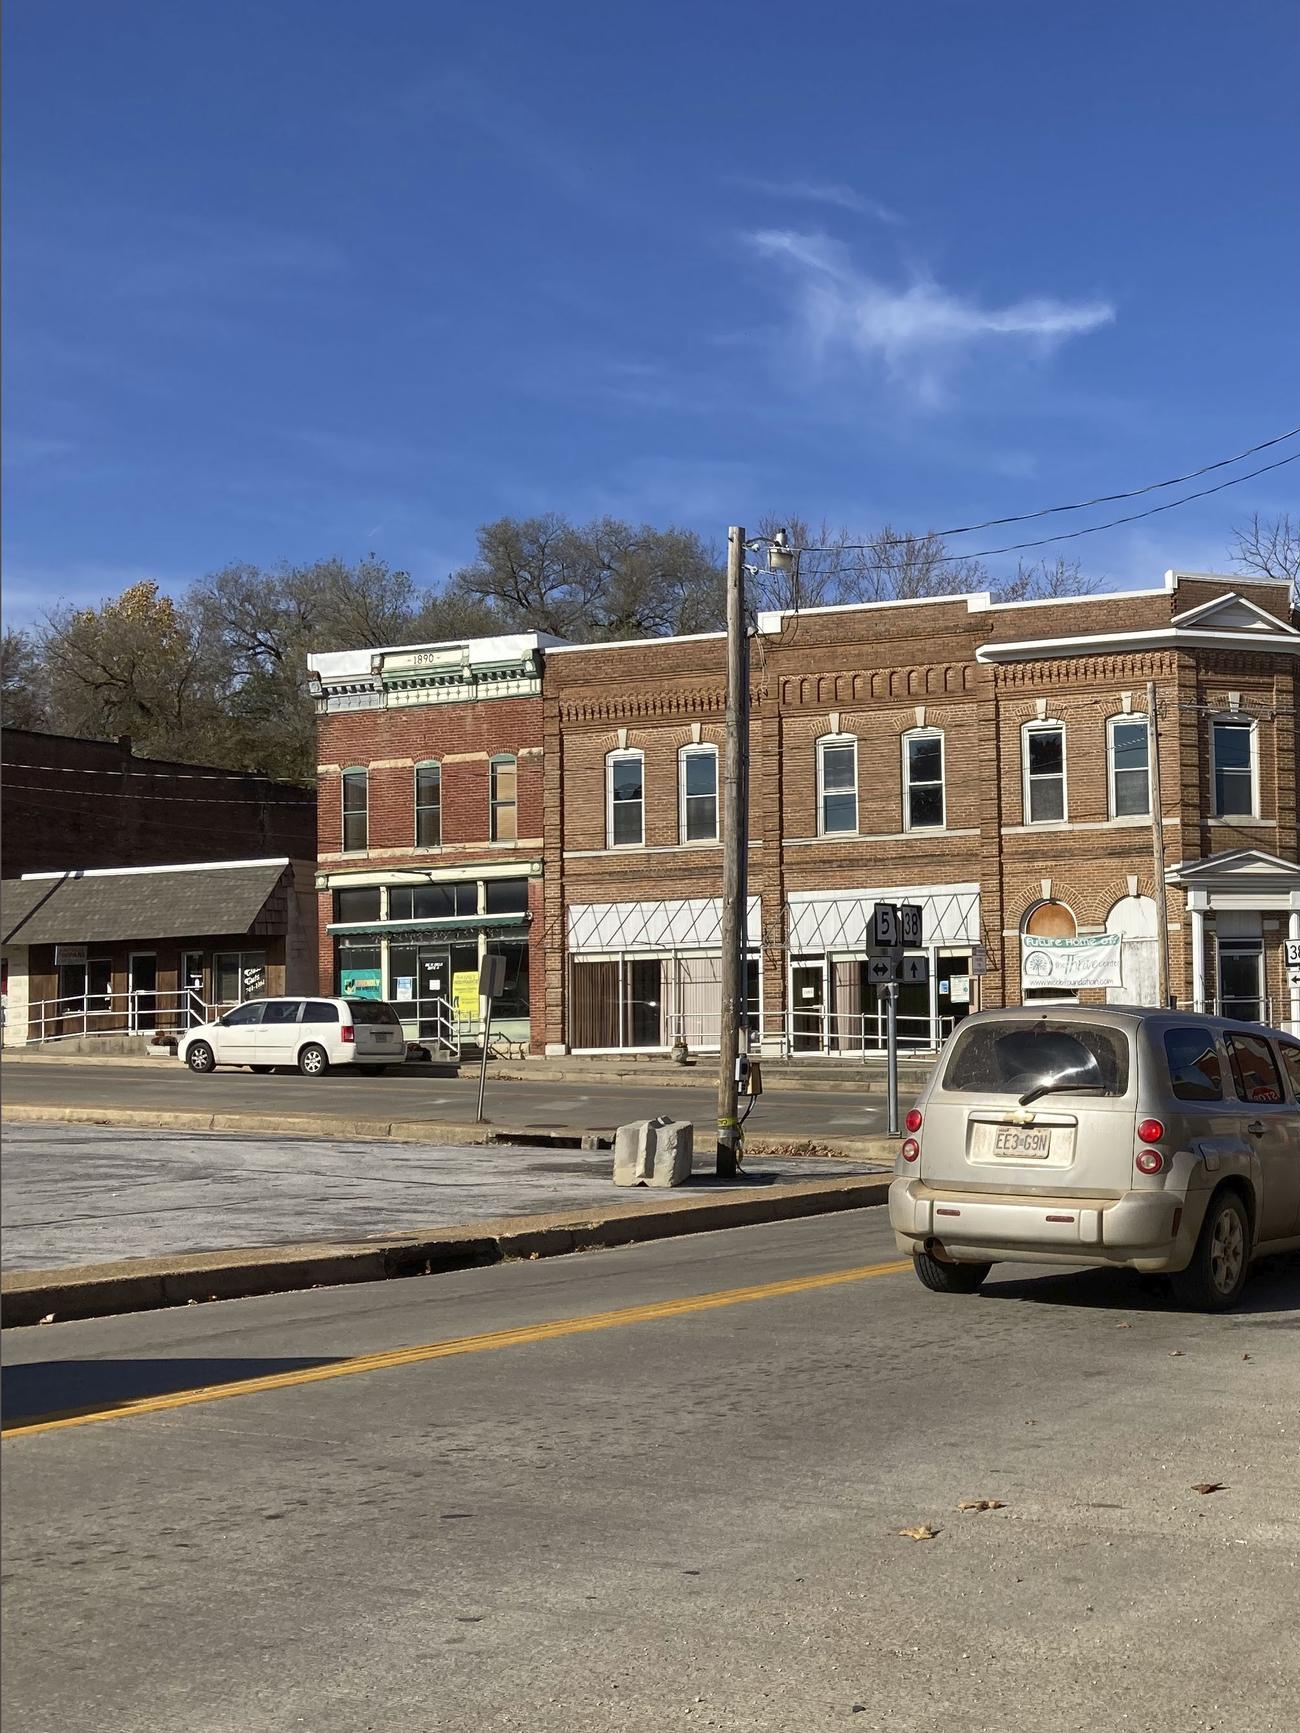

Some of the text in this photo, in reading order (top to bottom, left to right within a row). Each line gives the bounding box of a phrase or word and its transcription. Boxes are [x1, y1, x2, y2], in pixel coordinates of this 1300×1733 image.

[413, 653, 434, 664] 1890
[881, 911, 890, 935] 5
[904, 912, 919, 936] 38
[1026, 937, 1063, 947] Future
[1065, 937, 1097, 946] Home
